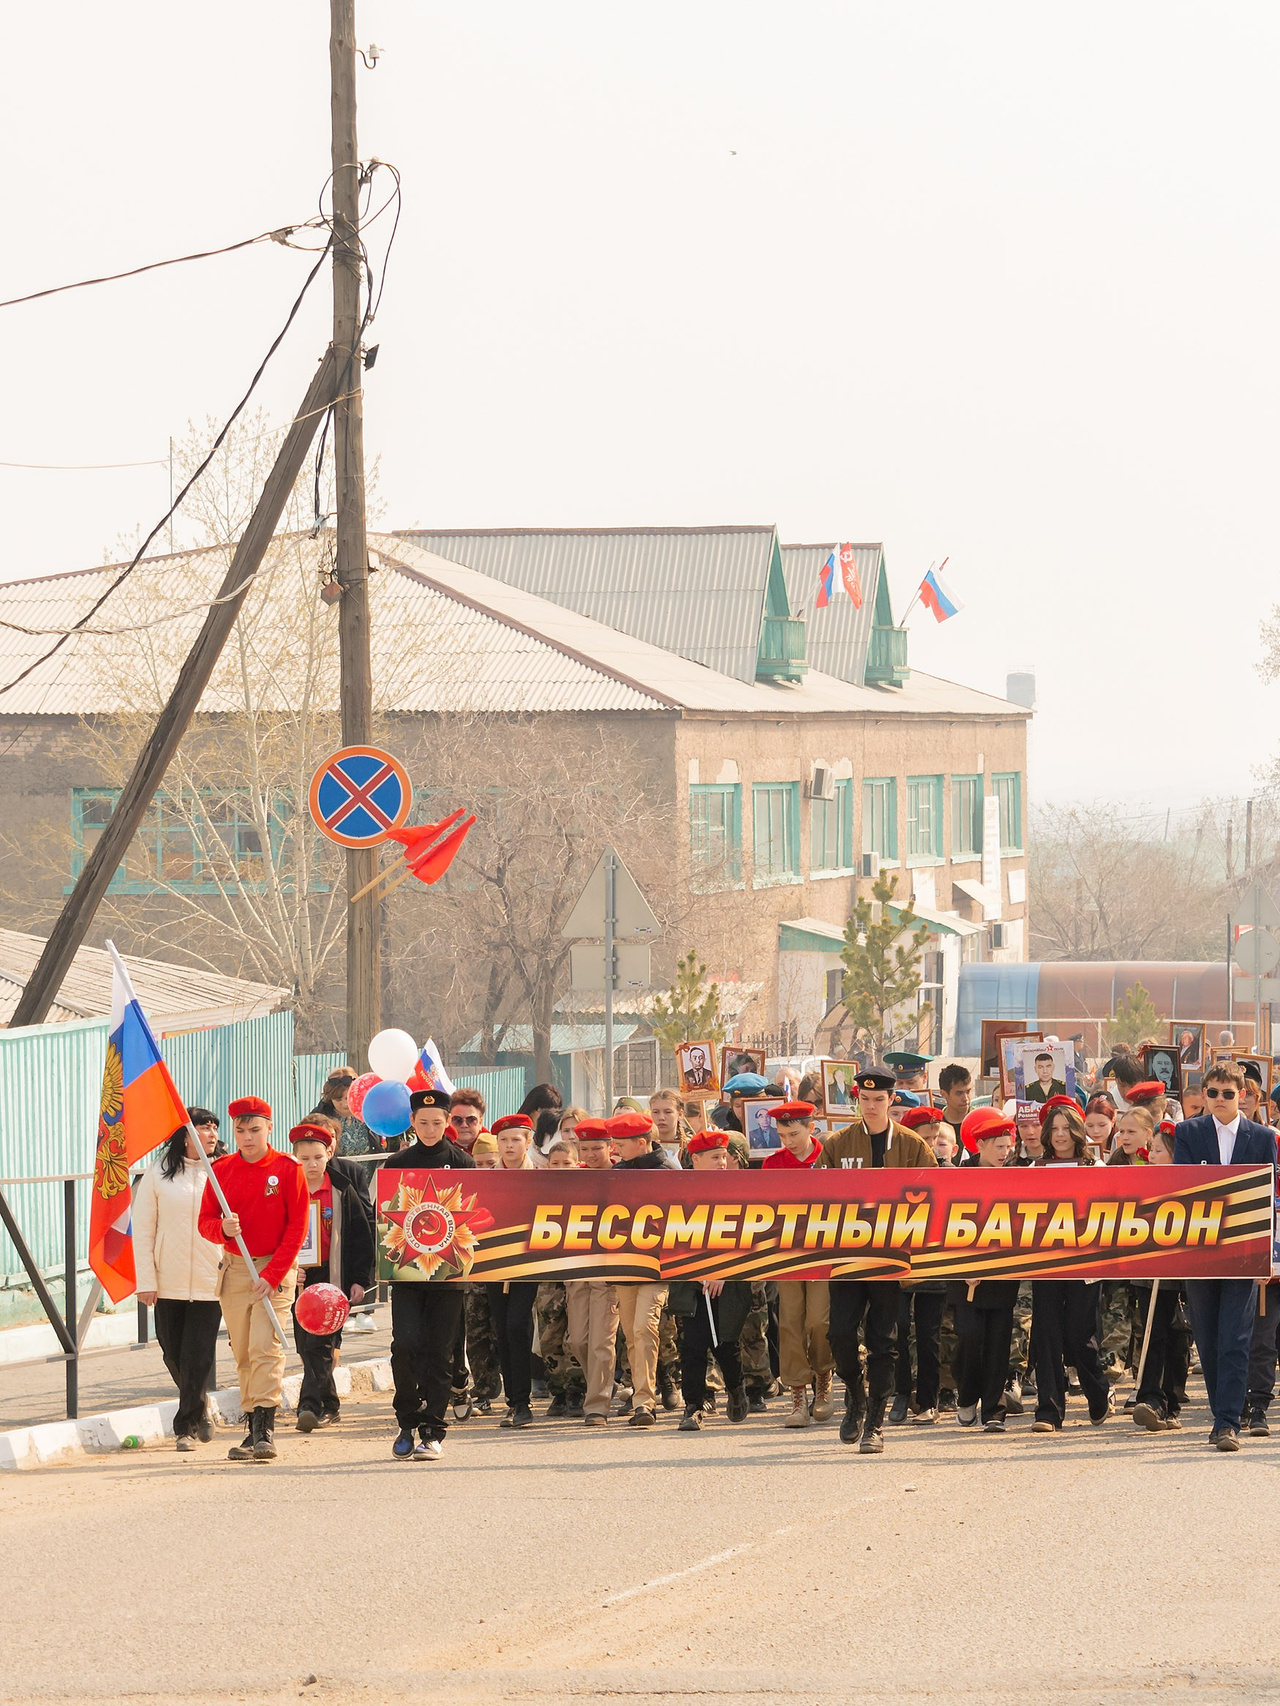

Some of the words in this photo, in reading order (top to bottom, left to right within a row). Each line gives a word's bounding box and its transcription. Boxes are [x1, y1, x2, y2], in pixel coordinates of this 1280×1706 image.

[405, 1203, 451, 1249] ОТЕЧЕСТВЕННАЯ
[438, 1219, 454, 1248] ВОЙНА
[528, 1191, 928, 1250] БЕССМЕРТНЫЙ
[944, 1200, 1225, 1248] БАТАЛЬОН
